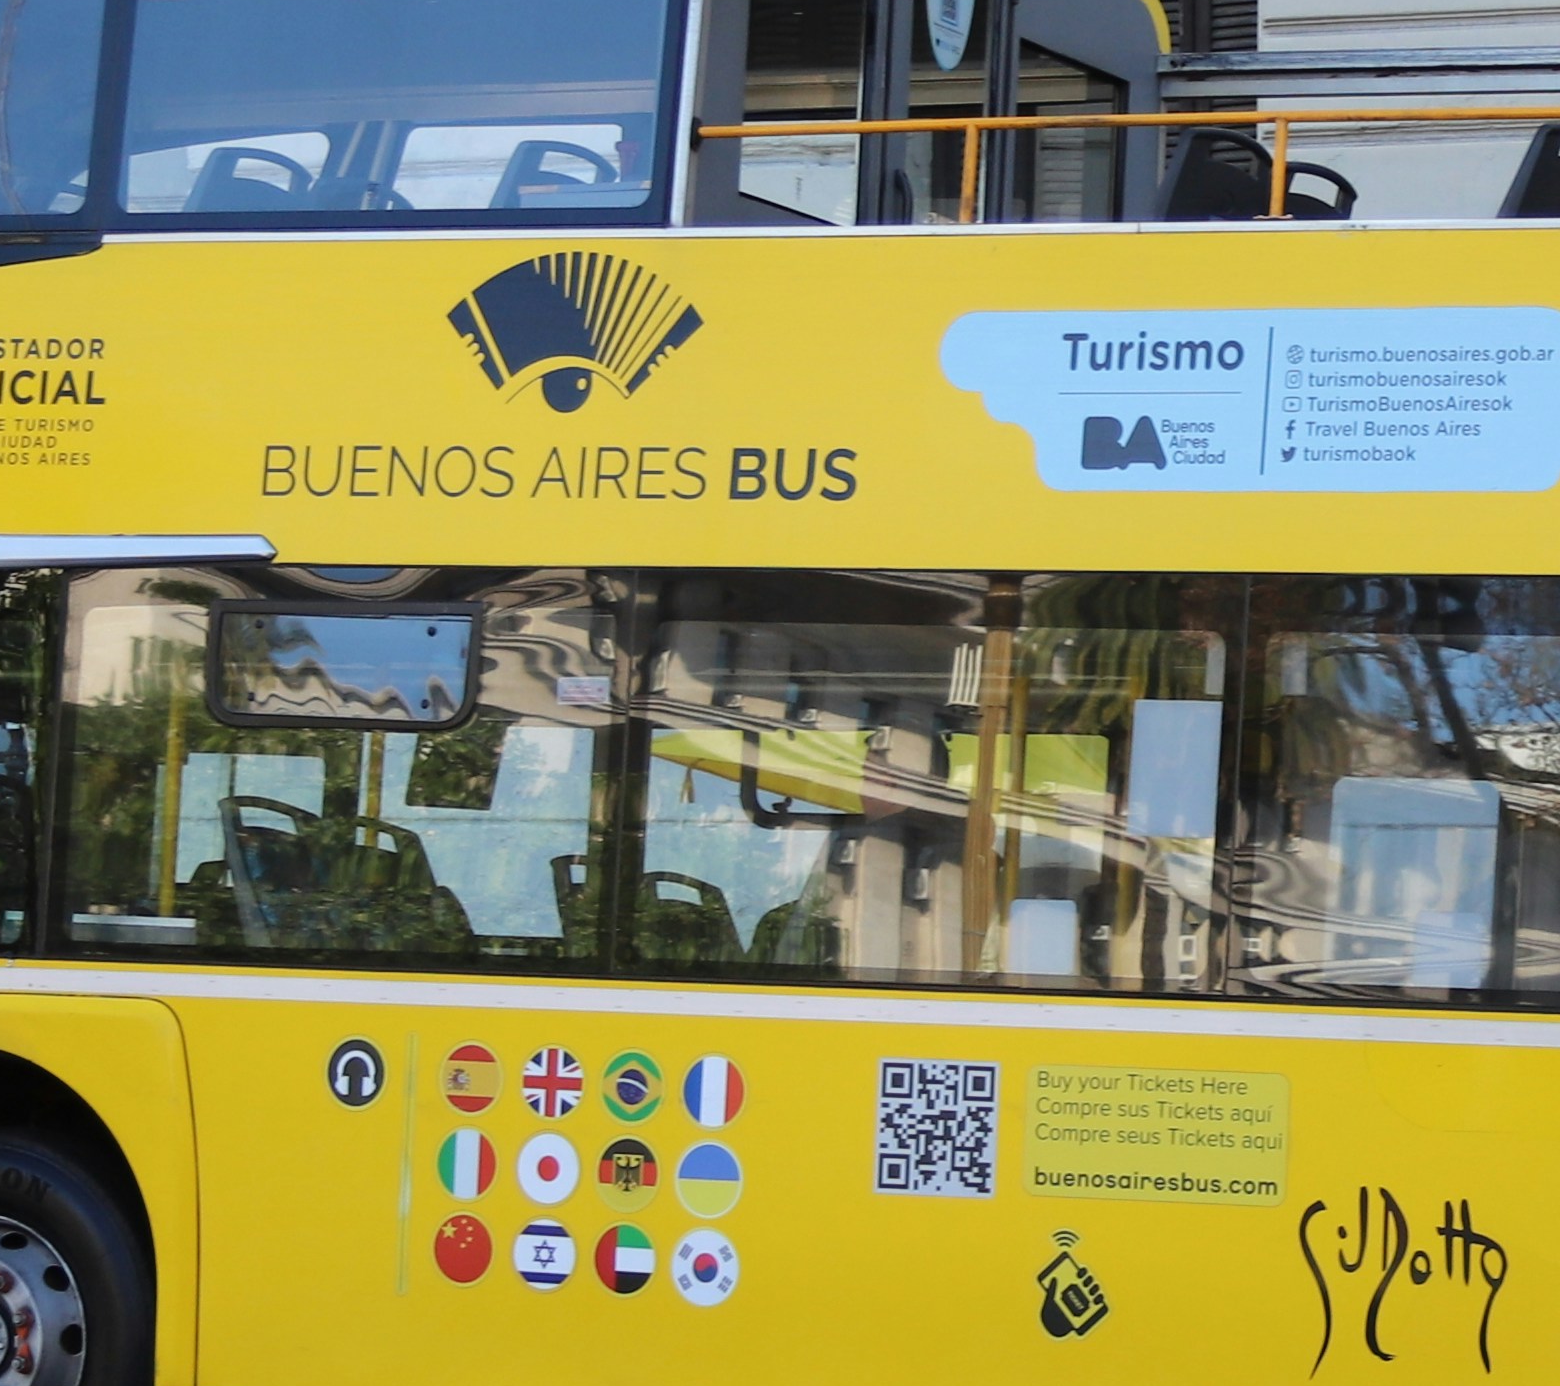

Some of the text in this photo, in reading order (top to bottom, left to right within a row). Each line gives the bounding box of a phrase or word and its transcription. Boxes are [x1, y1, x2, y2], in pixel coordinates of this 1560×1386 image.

[1062, 331, 1245, 371] Turismo
[1310, 346, 1554, 364] turismo.buenosaires.gob.ar
[1308, 370, 1507, 387] turismobuenosairesok
[1307, 396, 1513, 412] TurismoBuenosAiresok
[14, 419, 94, 432] TURISMO
[1161, 420, 1215, 433] Buenos
[1306, 420, 1482, 437] Travel Buenos Aires
[1081, 416, 1167, 470] BA
[1170, 436, 1209, 449] Aires
[38, 453, 91, 466] AIRES
[1173, 451, 1226, 464] Ciudad
[1303, 445, 1416, 462] turismobaok
[261, 445, 858, 501] BUENOS AIRES BUS
[1037, 1070, 1248, 1095] Buy your Tickets Here
[1036, 1097, 1274, 1126] Compre sus Tickets aquí
[1035, 1123, 1283, 1153] Compre seus Tickets aqui
[1034, 1167, 1278, 1196] buenosairesbus.com
